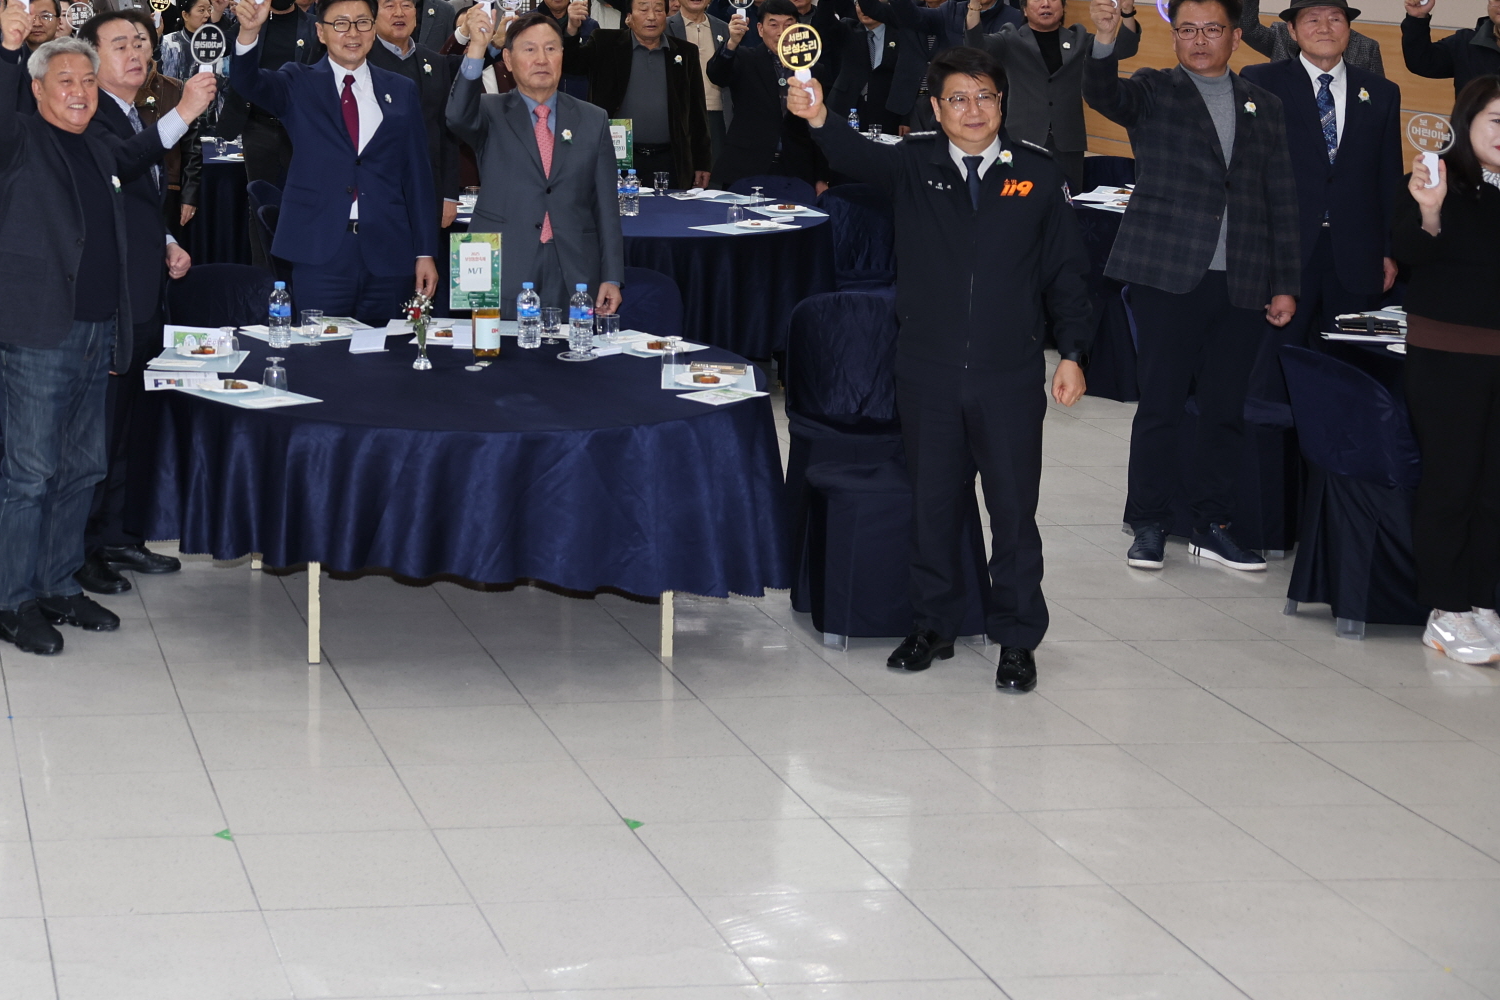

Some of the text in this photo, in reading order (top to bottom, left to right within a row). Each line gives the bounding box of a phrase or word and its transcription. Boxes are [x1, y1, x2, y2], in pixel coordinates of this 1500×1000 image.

[783, 39, 817, 55] 보성소리
[1419, 118, 1443, 129] 보성
[1412, 126, 1451, 141] 어린이날
[1000, 180, 1034, 196] 119
